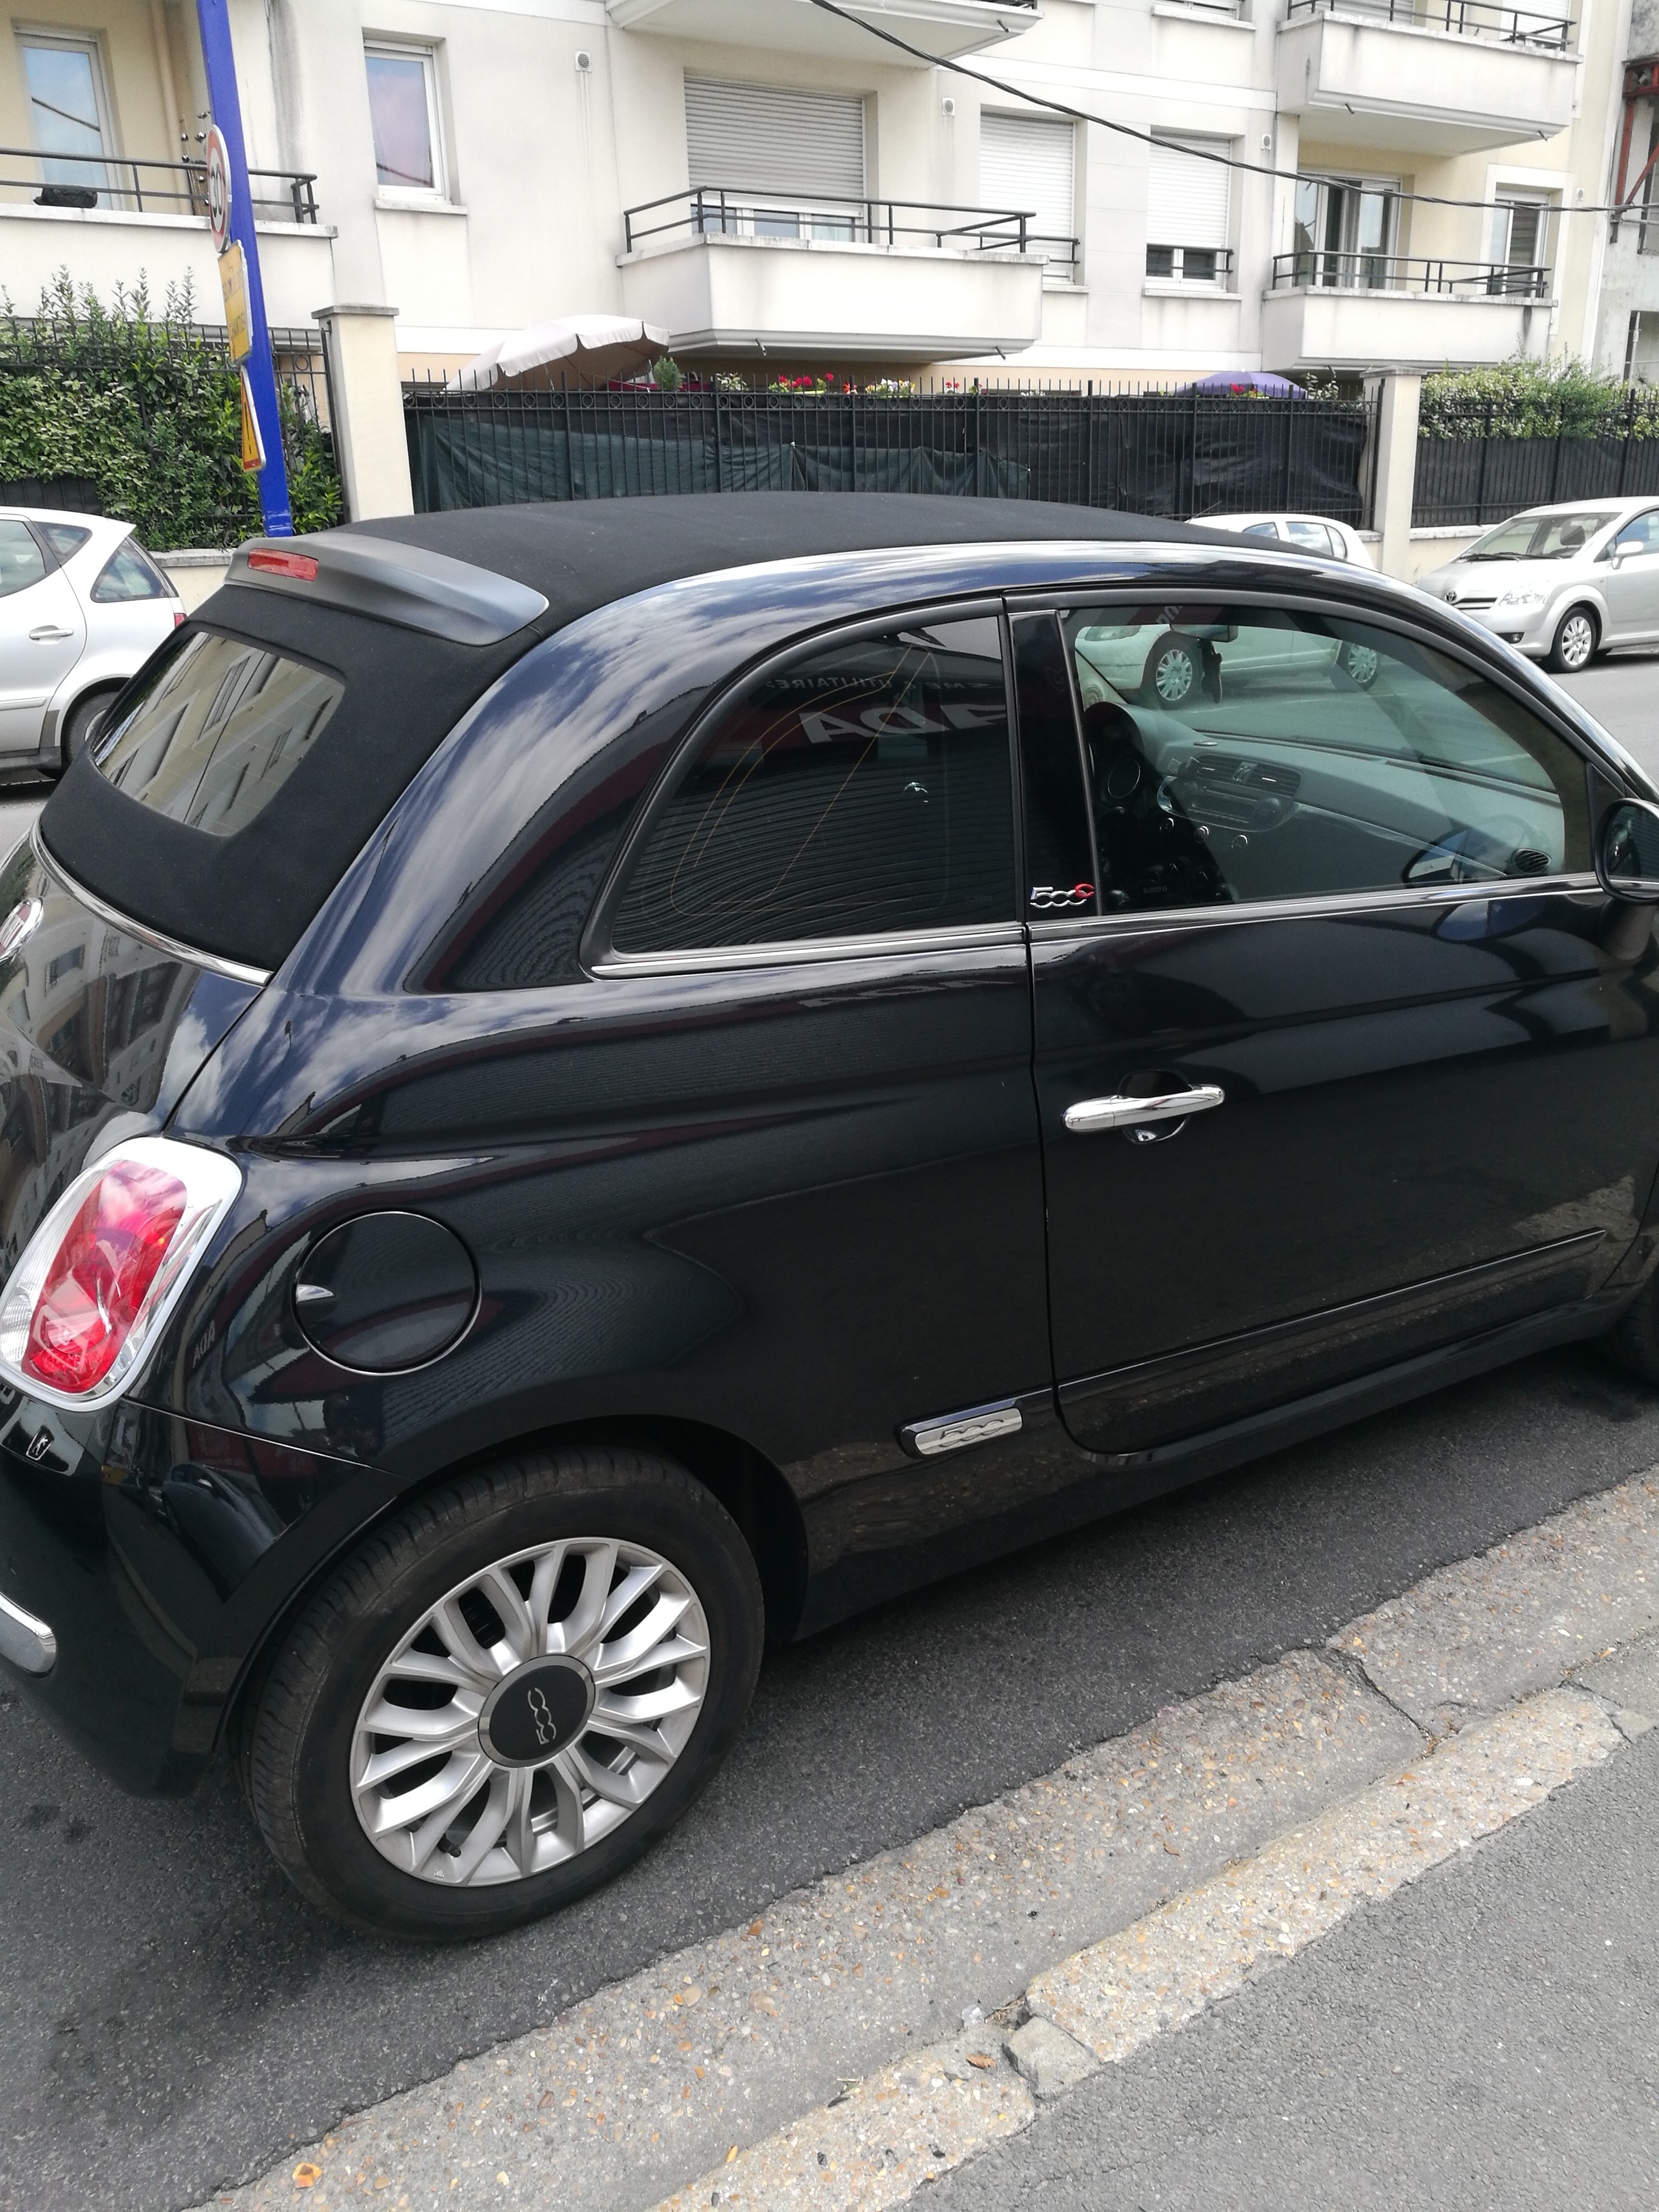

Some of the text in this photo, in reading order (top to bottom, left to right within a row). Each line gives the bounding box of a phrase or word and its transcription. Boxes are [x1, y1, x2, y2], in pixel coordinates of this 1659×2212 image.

[211, 163, 222, 217] 30
[938, 1419, 1005, 1447] 500
[527, 1687, 556, 1745] 500
